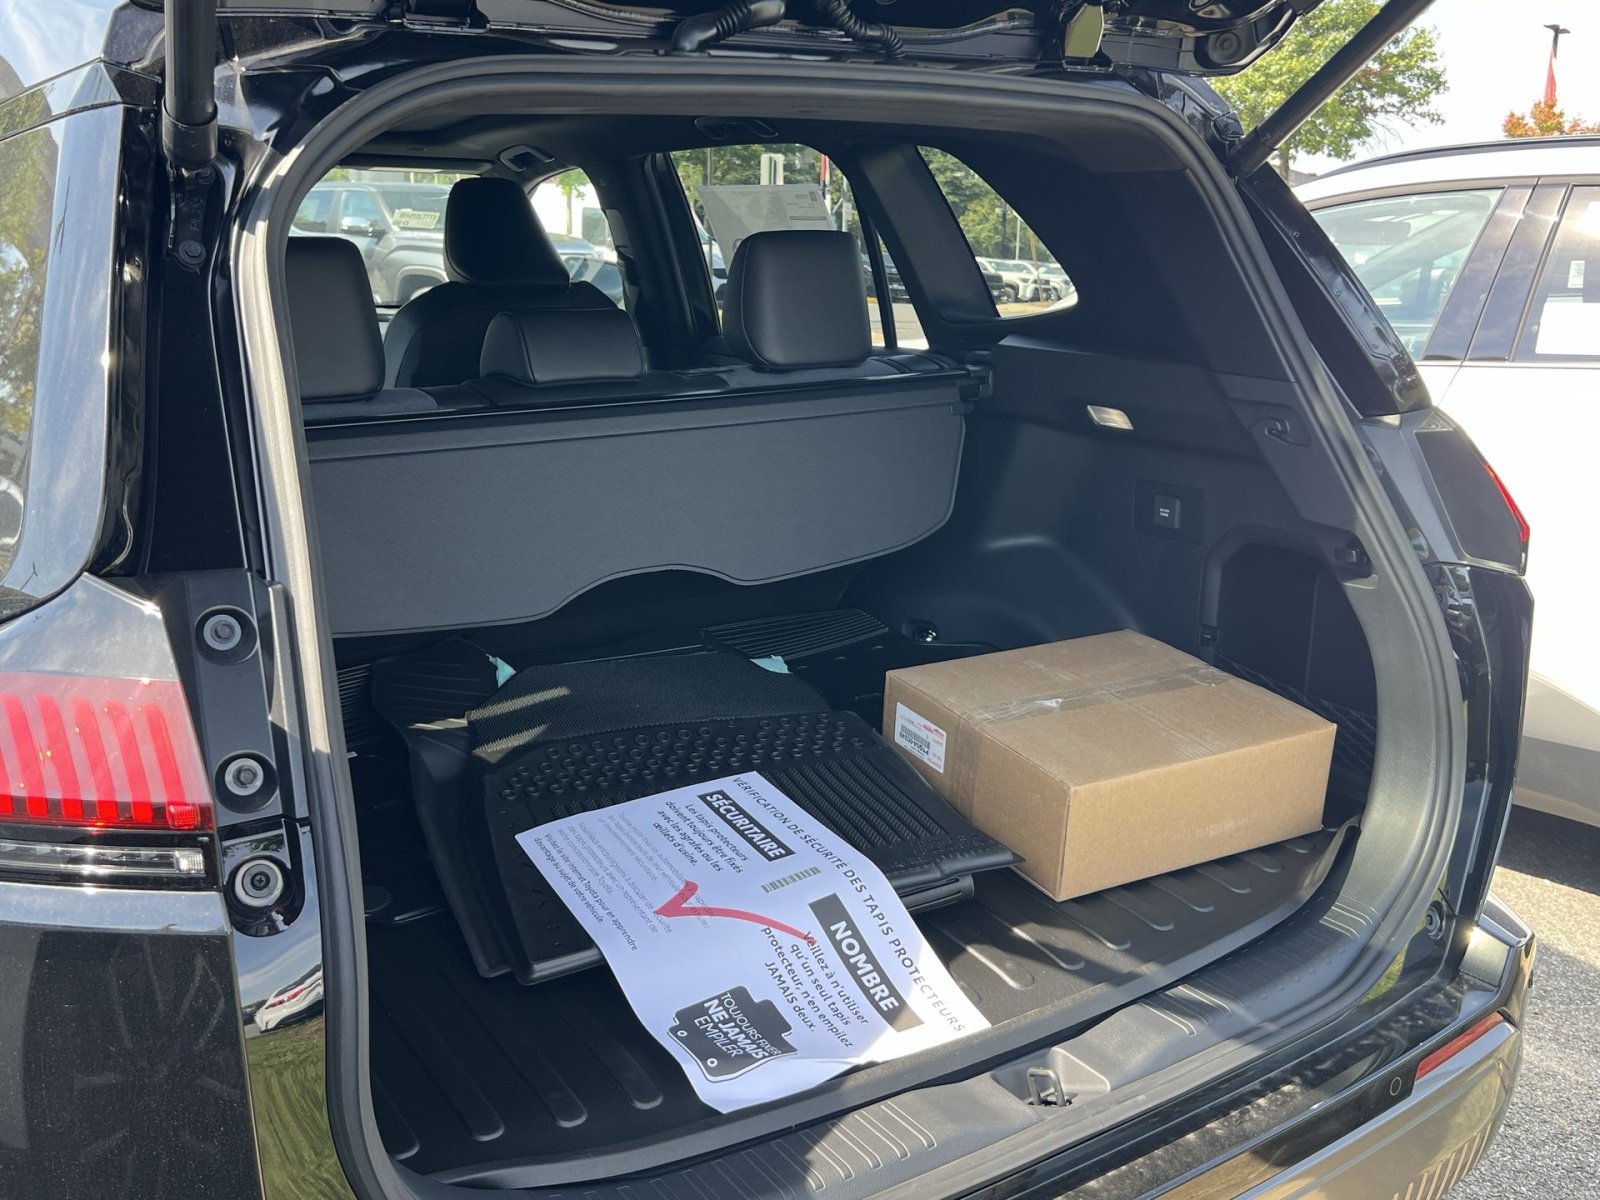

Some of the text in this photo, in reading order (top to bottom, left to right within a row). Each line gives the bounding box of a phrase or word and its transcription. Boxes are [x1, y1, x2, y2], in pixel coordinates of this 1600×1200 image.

[653, 822, 676, 843] œillets
[657, 810, 724, 872] avec les agrafes ou les
[665, 801, 744, 874] doivent toujours être fixés
[685, 804, 749, 861] Les tapis protecteurs
[706, 793, 786, 858] SÉCURITAIRE
[569, 880, 578, 888] de
[574, 887, 586, 901] votre
[582, 880, 601, 899] Toyota
[595, 898, 609, 911] pour
[607, 910, 615, 918] en
[611, 917, 638, 951] apprendre
[732, 777, 966, 1033] VÉRIFICATION DE SÉCURITÉ DES TAPIS PROTECTEURS
[761, 926, 853, 1048] protecteur, n'en empilez
[765, 962, 816, 1032] JAMAIS deux.
[790, 944, 851, 1026] qu'un seul tapis
[803, 931, 869, 1024] Veillez à n'utiliser
[830, 921, 899, 1011] NOMBRE
[694, 1016, 744, 1058] EMPILER
[704, 998, 769, 1059] NE JAMAIS
[721, 992, 782, 1056] TOUJOURS FIXER
